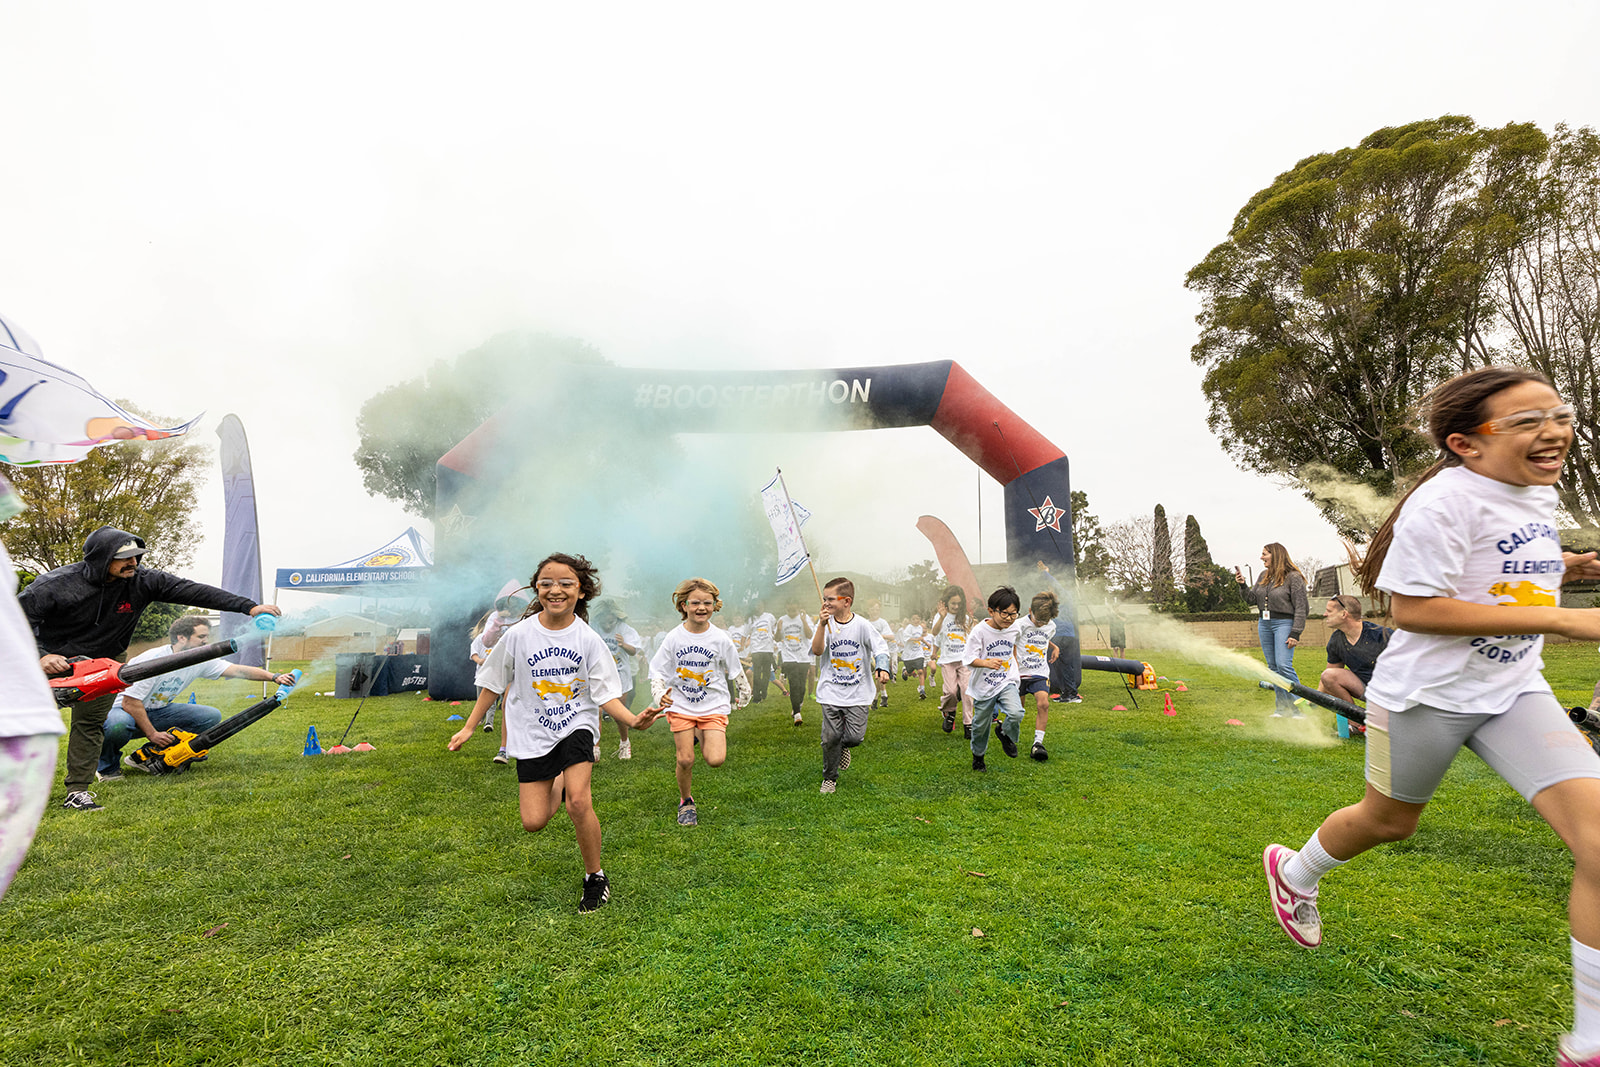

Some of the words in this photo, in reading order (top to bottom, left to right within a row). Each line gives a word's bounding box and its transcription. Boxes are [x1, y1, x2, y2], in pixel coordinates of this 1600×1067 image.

[633, 378, 872, 409] #BOOSTERTHON
[305, 573, 345, 583] CALIFORNIA
[346, 572, 388, 582] ELEMENTARY
[390, 571, 416, 581] SCHOOL
[527, 646, 583, 667] CALIFORNIA
[675, 645, 714, 660] CALIFORNIA
[531, 667, 580, 678] ELEMENTARY
[544, 703, 572, 717] OUGR
